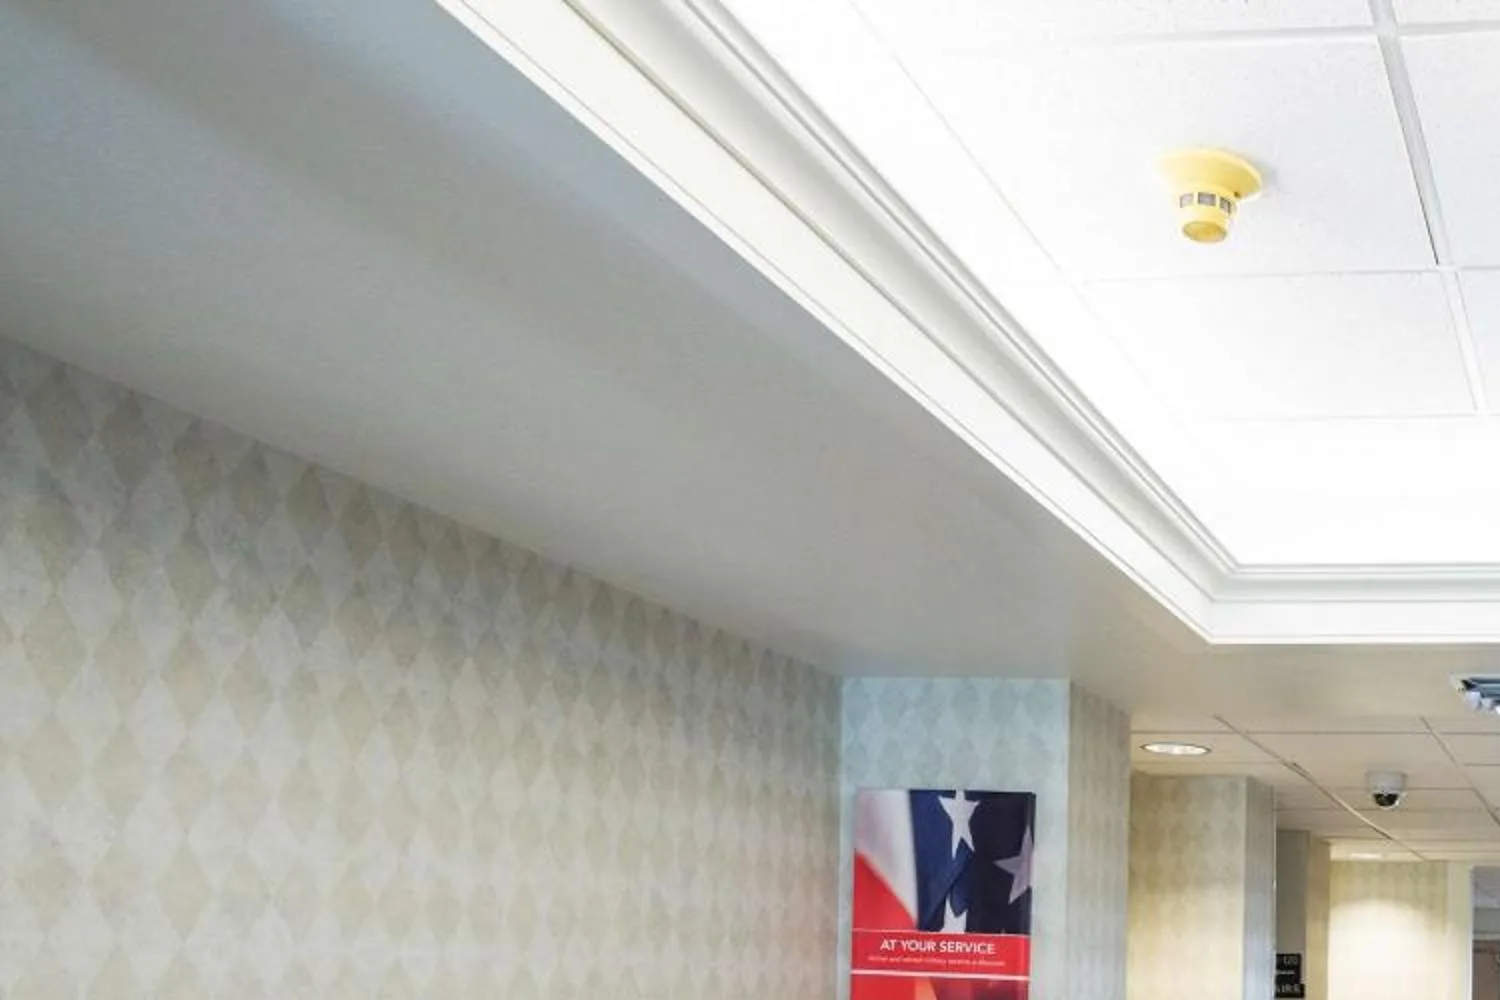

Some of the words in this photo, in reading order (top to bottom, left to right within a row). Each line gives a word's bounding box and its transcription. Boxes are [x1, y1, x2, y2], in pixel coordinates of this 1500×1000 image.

[880, 940, 897, 951] AT
[900, 940, 937, 952] YOUR
[939, 941, 996, 955] SERVICE
